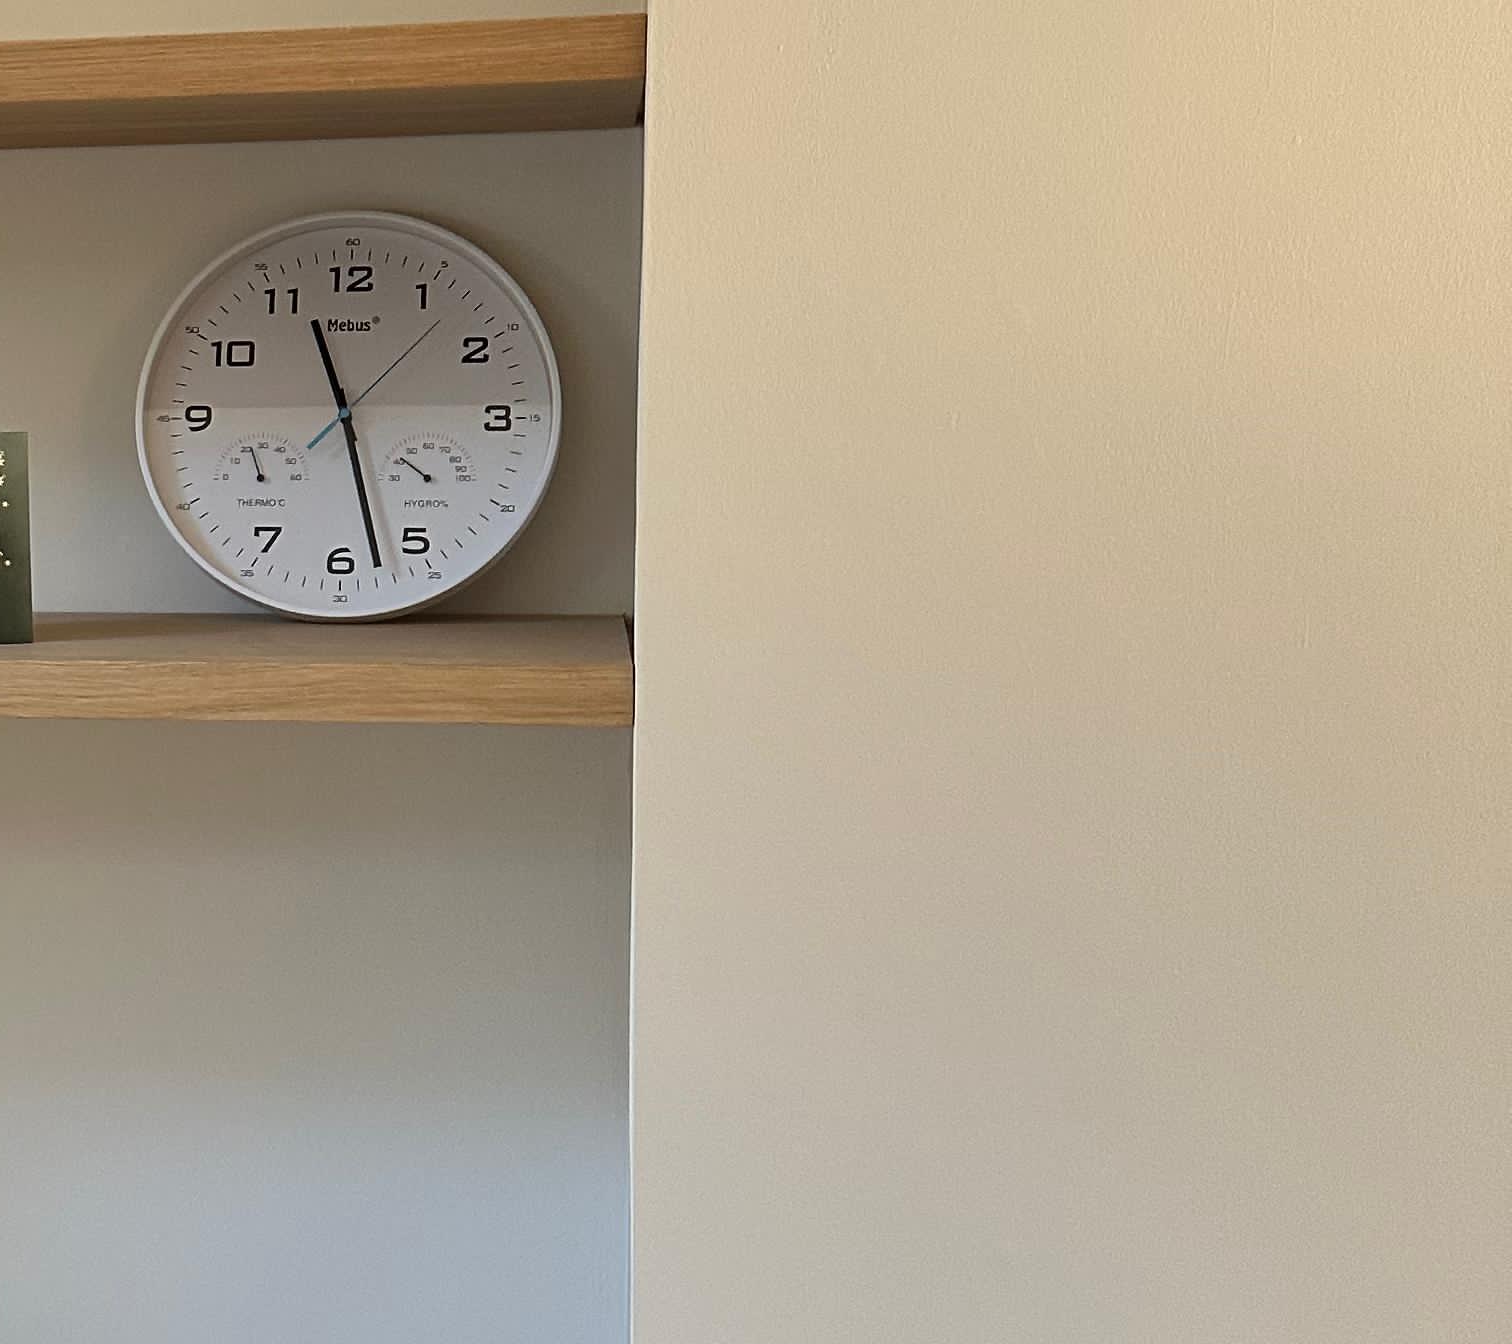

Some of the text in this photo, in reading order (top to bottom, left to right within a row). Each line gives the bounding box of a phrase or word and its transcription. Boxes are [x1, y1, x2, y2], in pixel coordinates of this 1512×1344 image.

[345, 238, 361, 246] 60
[254, 263, 268, 271] 55
[440, 260, 449, 268] 5
[329, 265, 374, 293] 12
[264, 287, 299, 315] 11
[415, 283, 428, 310] 1
[184, 326, 200, 334] 50
[506, 323, 520, 332] 10
[210, 340, 256, 367] 10
[461, 336, 490, 364] 2
[184, 405, 213, 432] 9
[483, 404, 512, 432] 3
[529, 414, 540, 422] 15
[176, 503, 190, 511] 40
[500, 505, 515, 513] 20
[253, 526, 283, 554] 7
[401, 527, 430, 555] 5
[326, 547, 355, 575] 6
[240, 569, 254, 577] 35
[427, 571, 442, 579] 25
